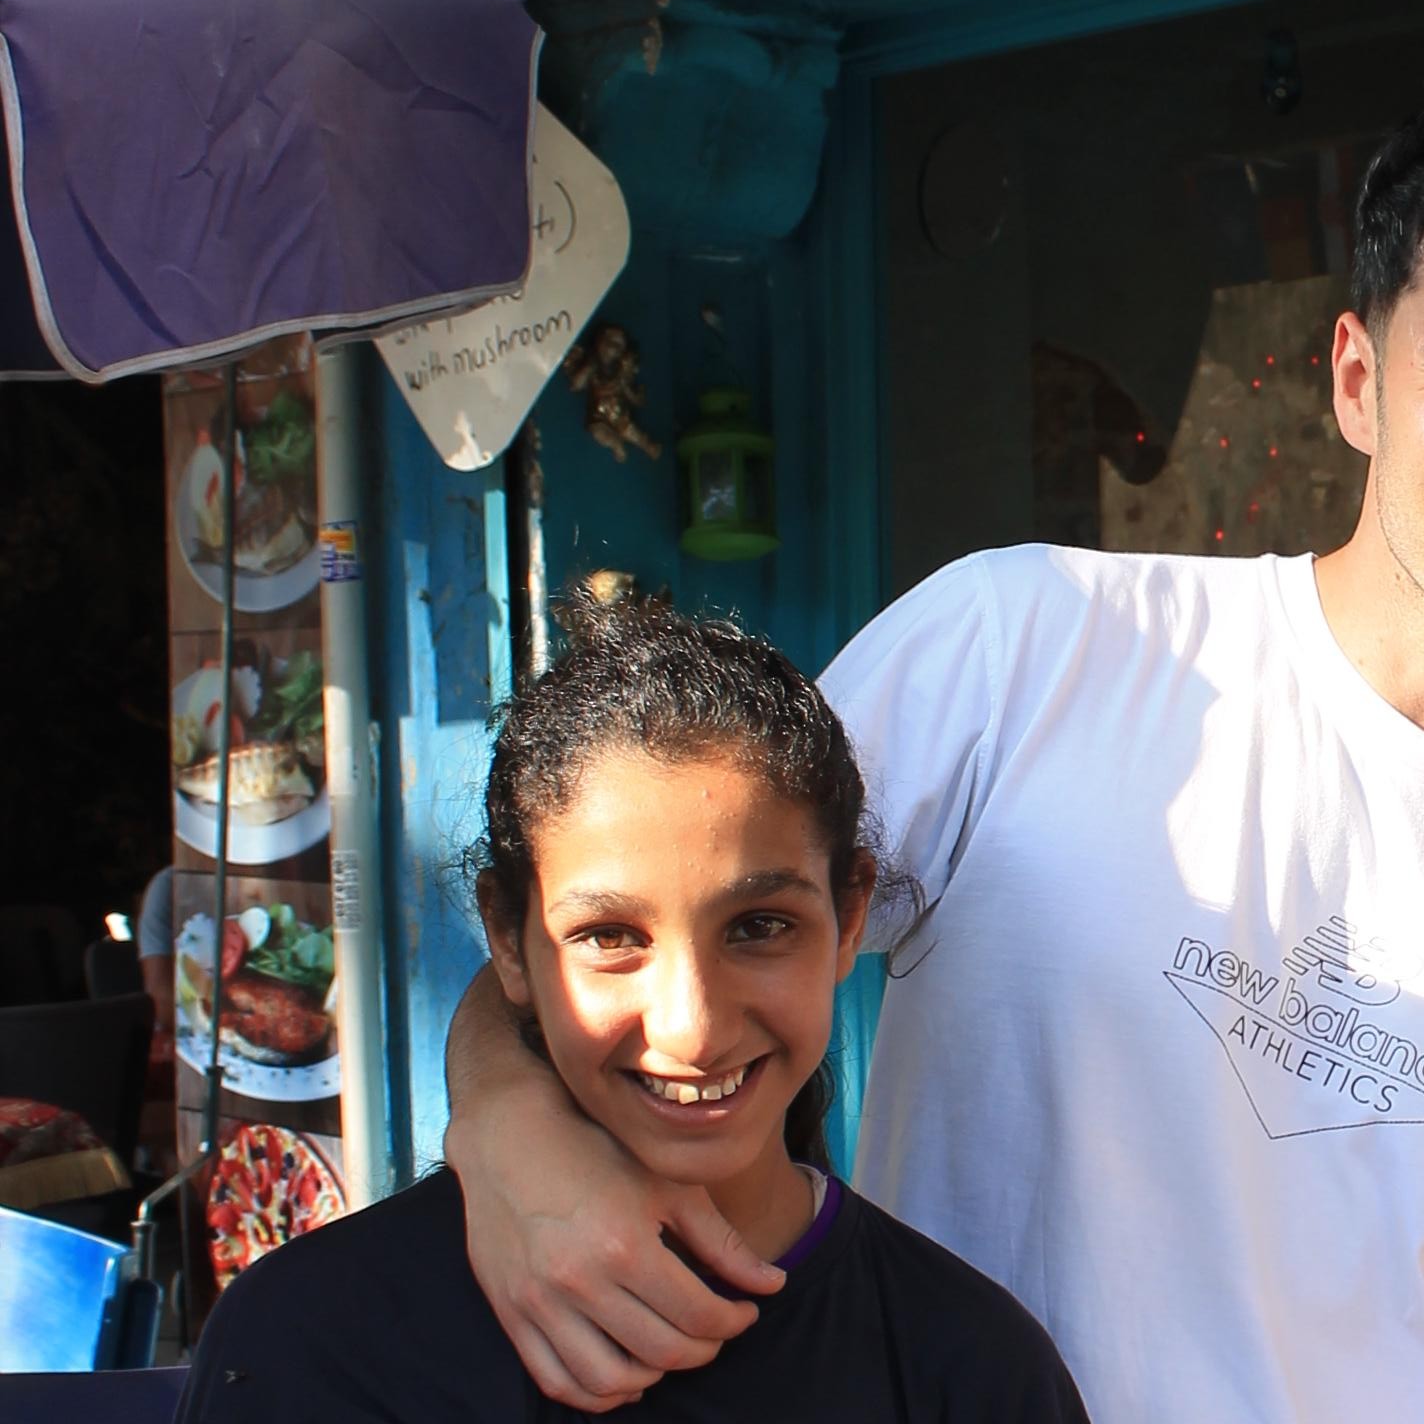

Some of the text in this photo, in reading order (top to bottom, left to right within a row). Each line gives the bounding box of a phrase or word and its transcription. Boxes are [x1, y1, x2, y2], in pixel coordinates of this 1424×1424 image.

[404, 350, 449, 392] with
[1173, 937, 1277, 1005] new
[1228, 1014, 1400, 1113] ATHLETICS
